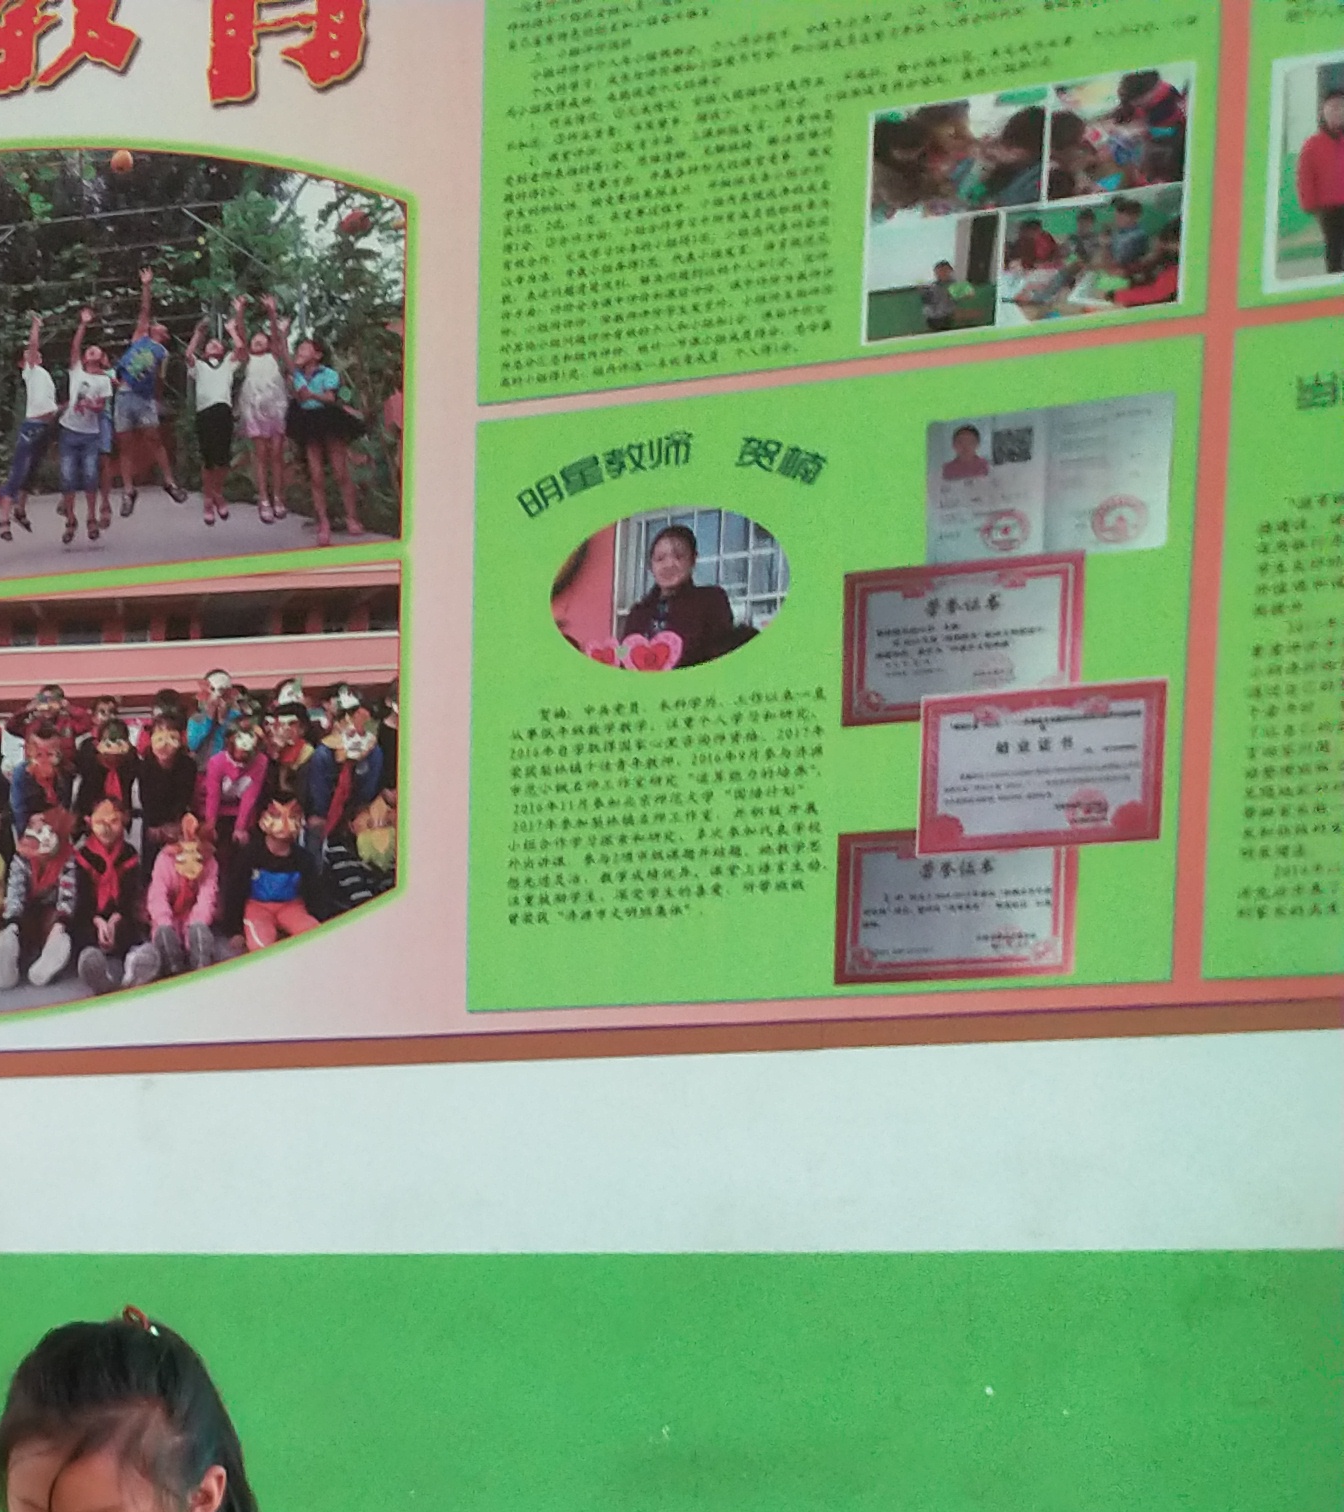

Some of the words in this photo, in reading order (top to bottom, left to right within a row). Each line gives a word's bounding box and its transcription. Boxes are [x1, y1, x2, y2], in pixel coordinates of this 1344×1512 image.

[515, 430, 694, 518] 明星教师
[733, 435, 828, 486] 贺楠
